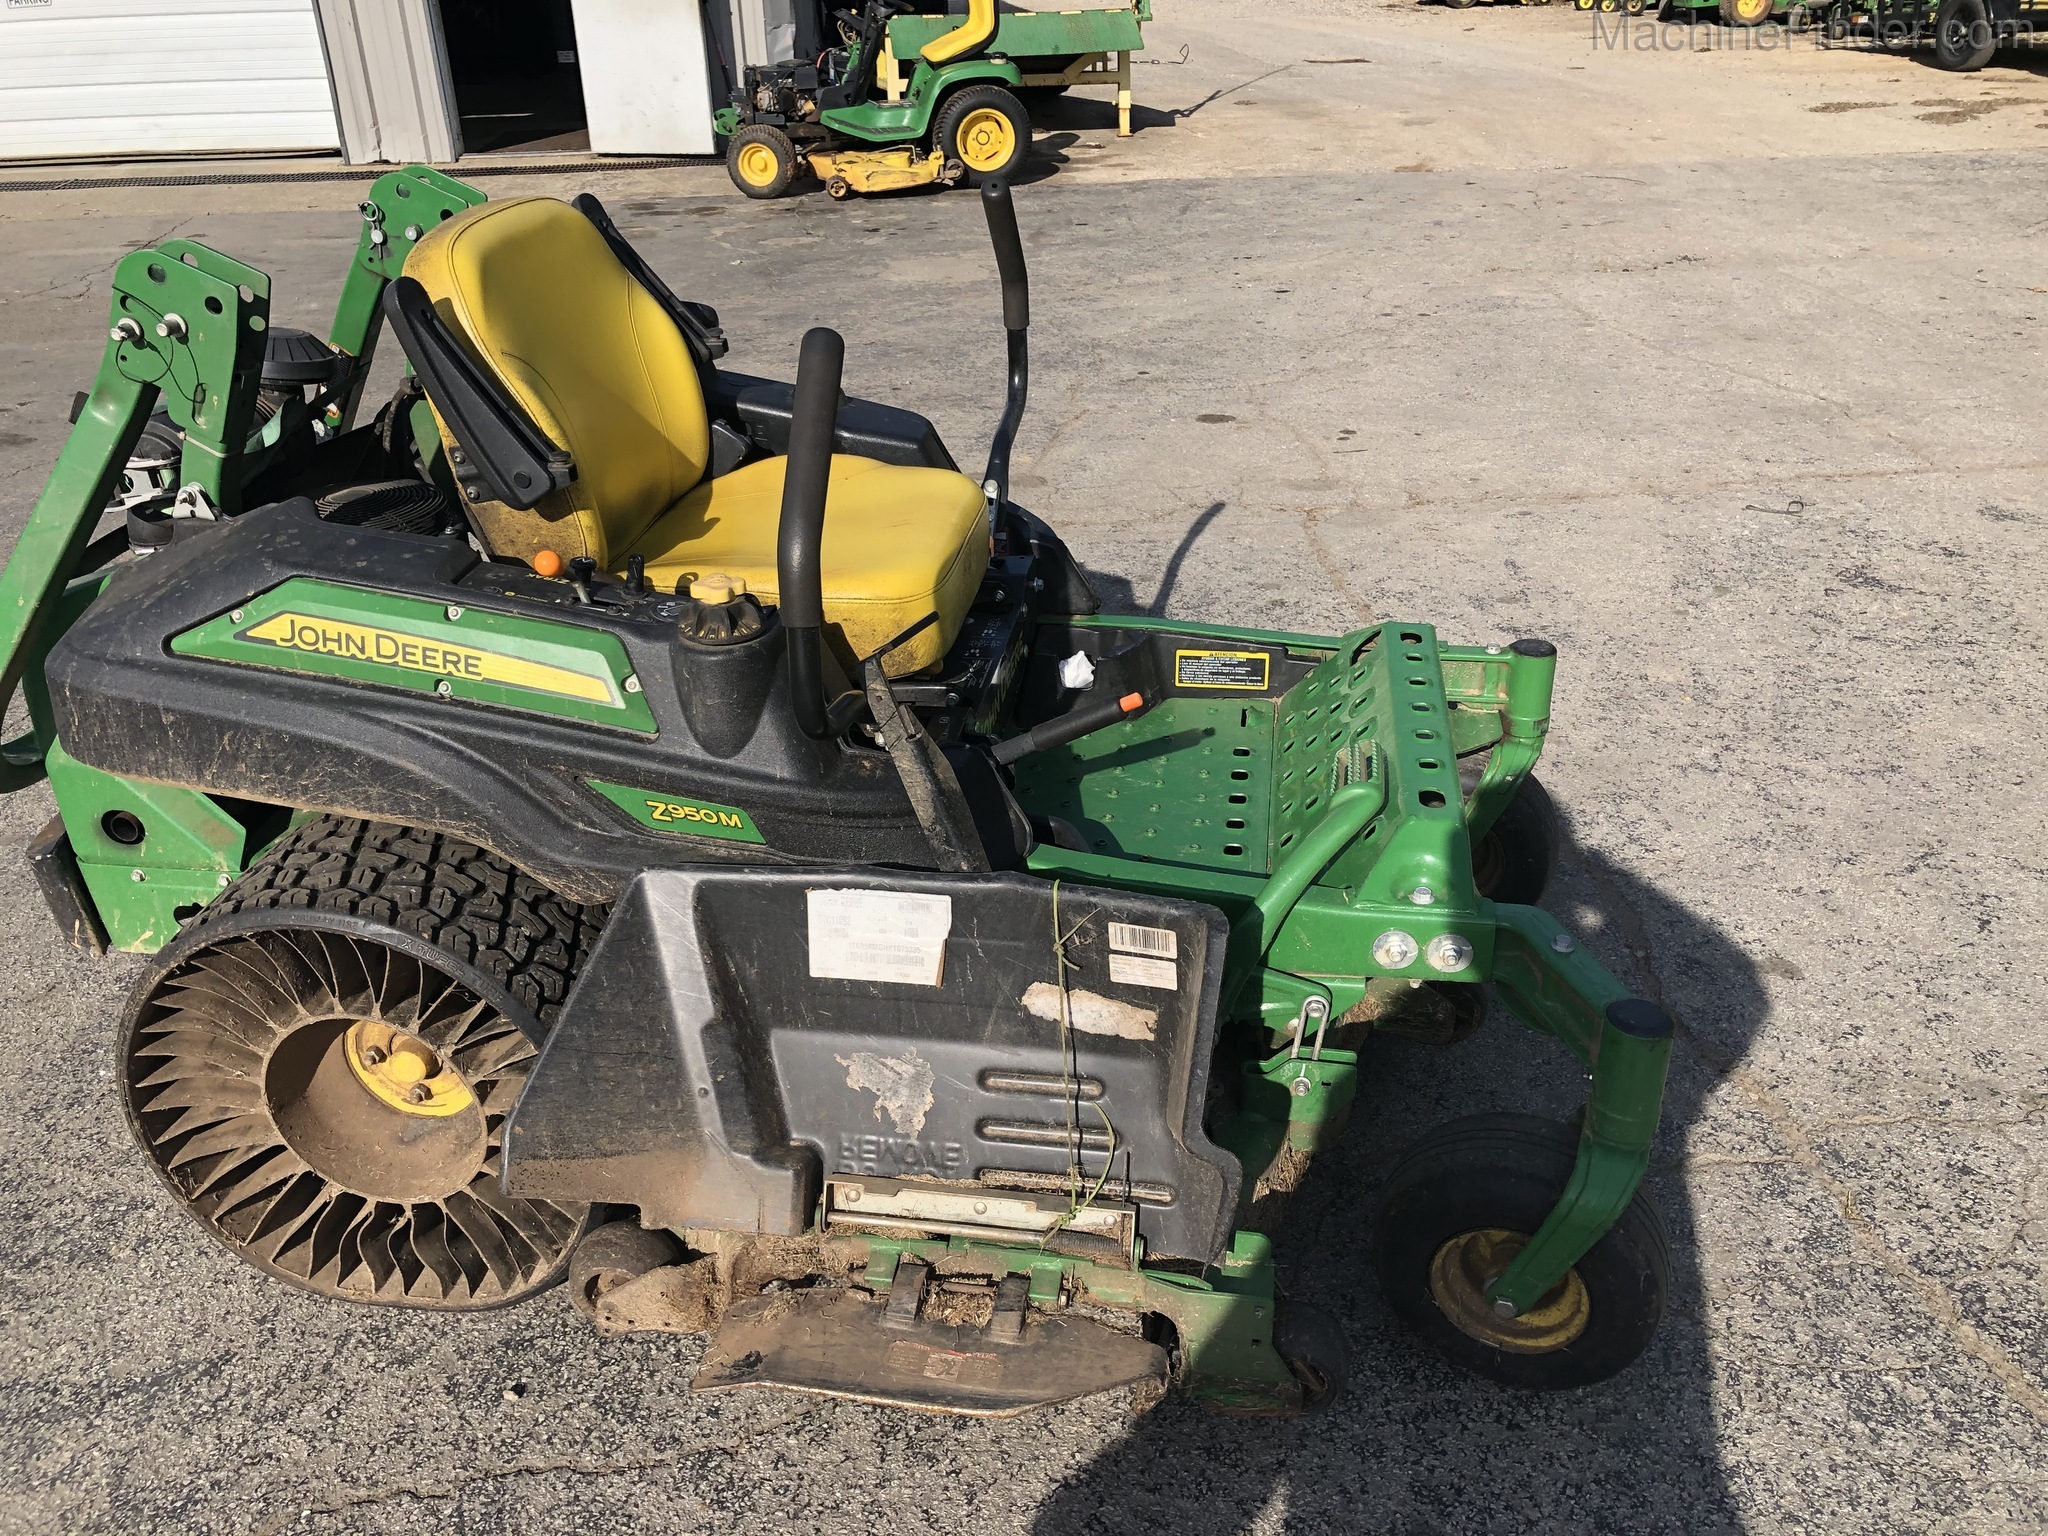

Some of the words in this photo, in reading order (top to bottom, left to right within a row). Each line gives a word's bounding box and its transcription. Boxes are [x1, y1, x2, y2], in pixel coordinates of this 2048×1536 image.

[280, 619, 366, 656] JOHN
[376, 634, 483, 677] DEERE
[645, 800, 744, 830] Z950M
[418, 943, 466, 978] TWEEL
